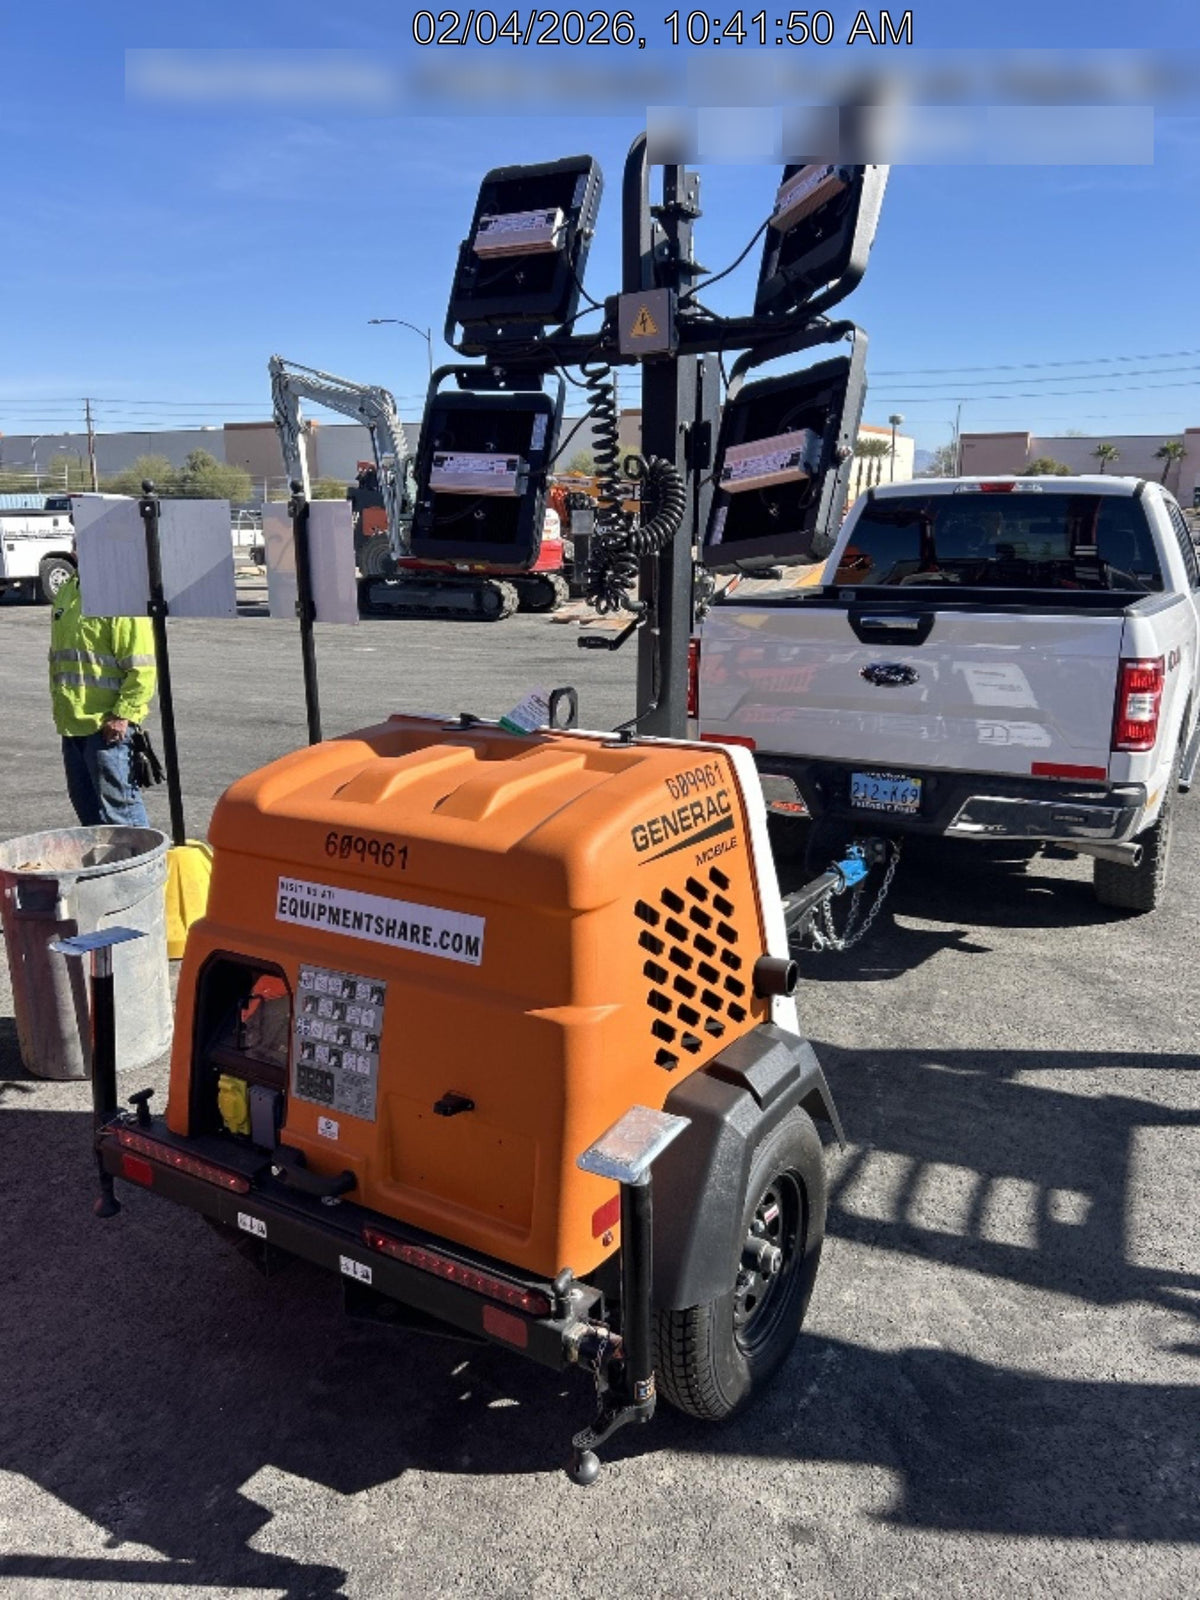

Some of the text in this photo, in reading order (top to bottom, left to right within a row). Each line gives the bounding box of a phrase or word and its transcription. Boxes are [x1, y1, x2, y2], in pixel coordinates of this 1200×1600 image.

[665, 761, 725, 800] 609961
[631, 789, 731, 852] GENERAC
[325, 831, 409, 870] 609961
[695, 836, 738, 866] MOBILE
[279, 895, 480, 957] EQUIPMENTSHARE.COM
